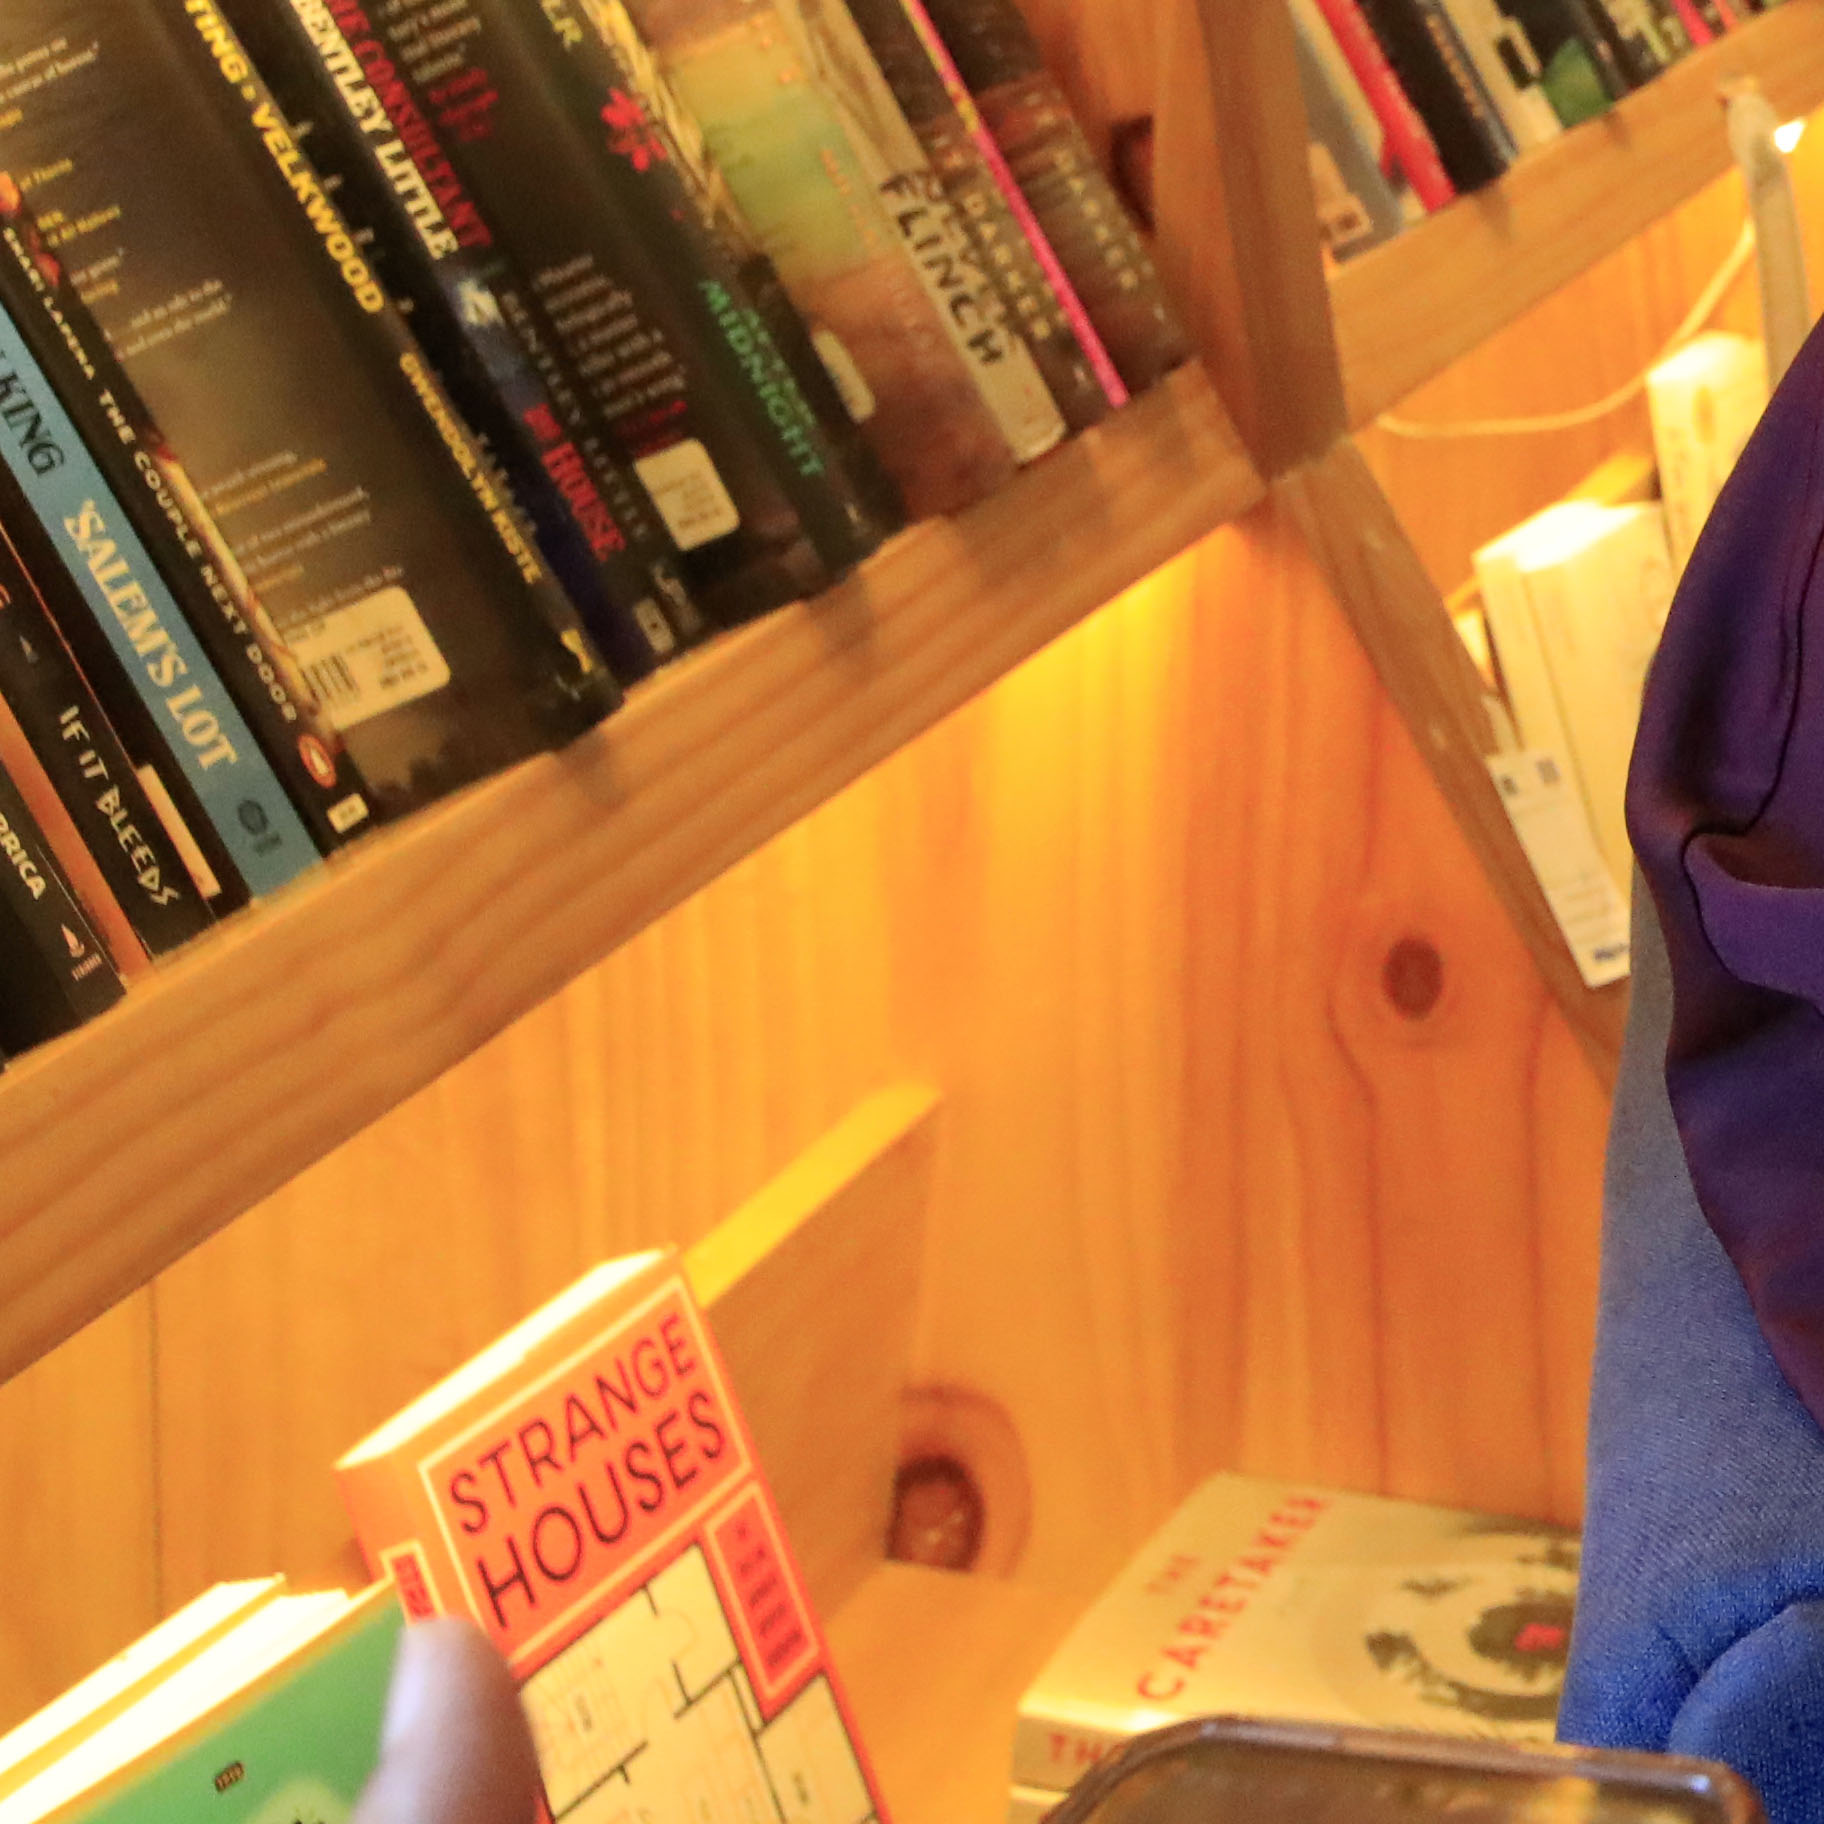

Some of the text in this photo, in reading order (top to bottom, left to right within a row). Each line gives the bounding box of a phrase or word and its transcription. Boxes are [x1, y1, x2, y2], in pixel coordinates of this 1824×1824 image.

[244, 99, 388, 320] VELKWOOD
[347, 33, 495, 256] CONSULTANT
[371, 135, 463, 264] LITTLE
[1049, 145, 1143, 296] DARKER
[876, 170, 1006, 374] FLINCH
[959, 189, 1057, 345] DARKER
[395, 350, 501, 515] GWENDOLYN
[489, 508, 545, 587] KISTE
[691, 275, 826, 482] MIDNIGHT
[94, 387, 300, 727] THE COUPLE NEXT DOOR
[540, 441, 630, 563] HOUSE
[51, 703, 184, 914] IF IT BLEEDS
[162, 681, 241, 779] LOT
[449, 1311, 696, 1534] STRANGE
[477, 1390, 726, 1629] HOUSES
[1136, 1493, 1332, 1702] CARETAKER
